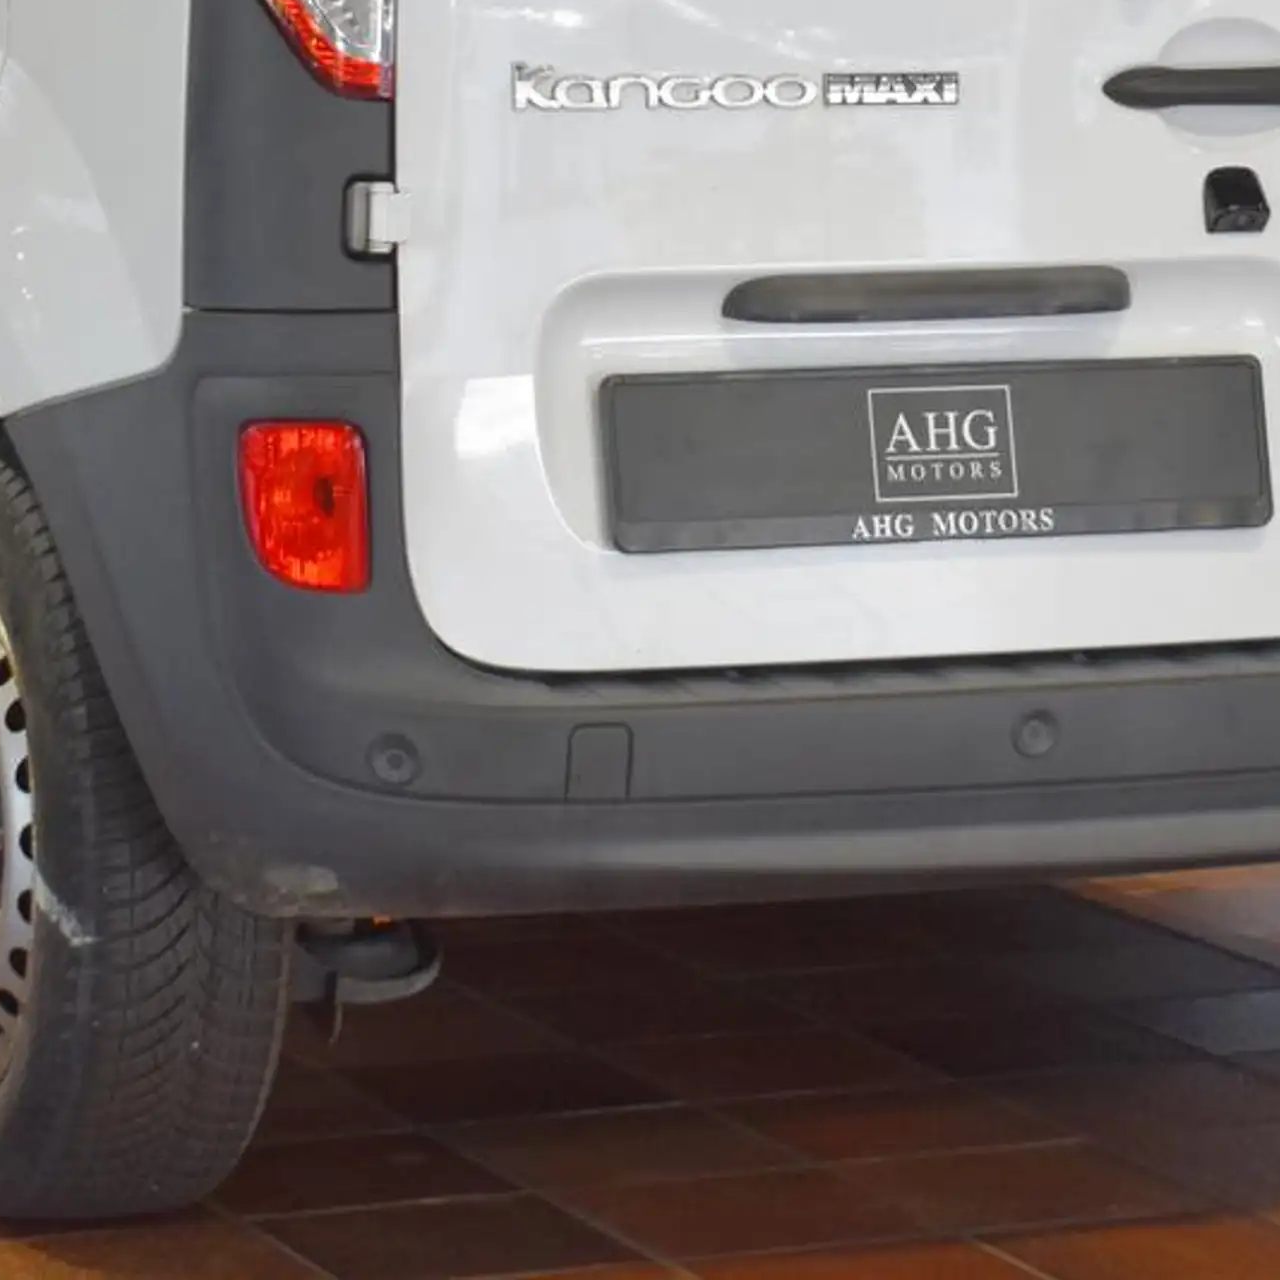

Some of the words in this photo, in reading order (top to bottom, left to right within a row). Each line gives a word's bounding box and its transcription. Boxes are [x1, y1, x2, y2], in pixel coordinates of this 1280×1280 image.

[823, 72, 959, 107] MAXI
[885, 409, 998, 453] AHG
[887, 460, 1002, 481] MOTORS
[852, 514, 915, 540] AHG
[931, 507, 1054, 536] MOTORS
